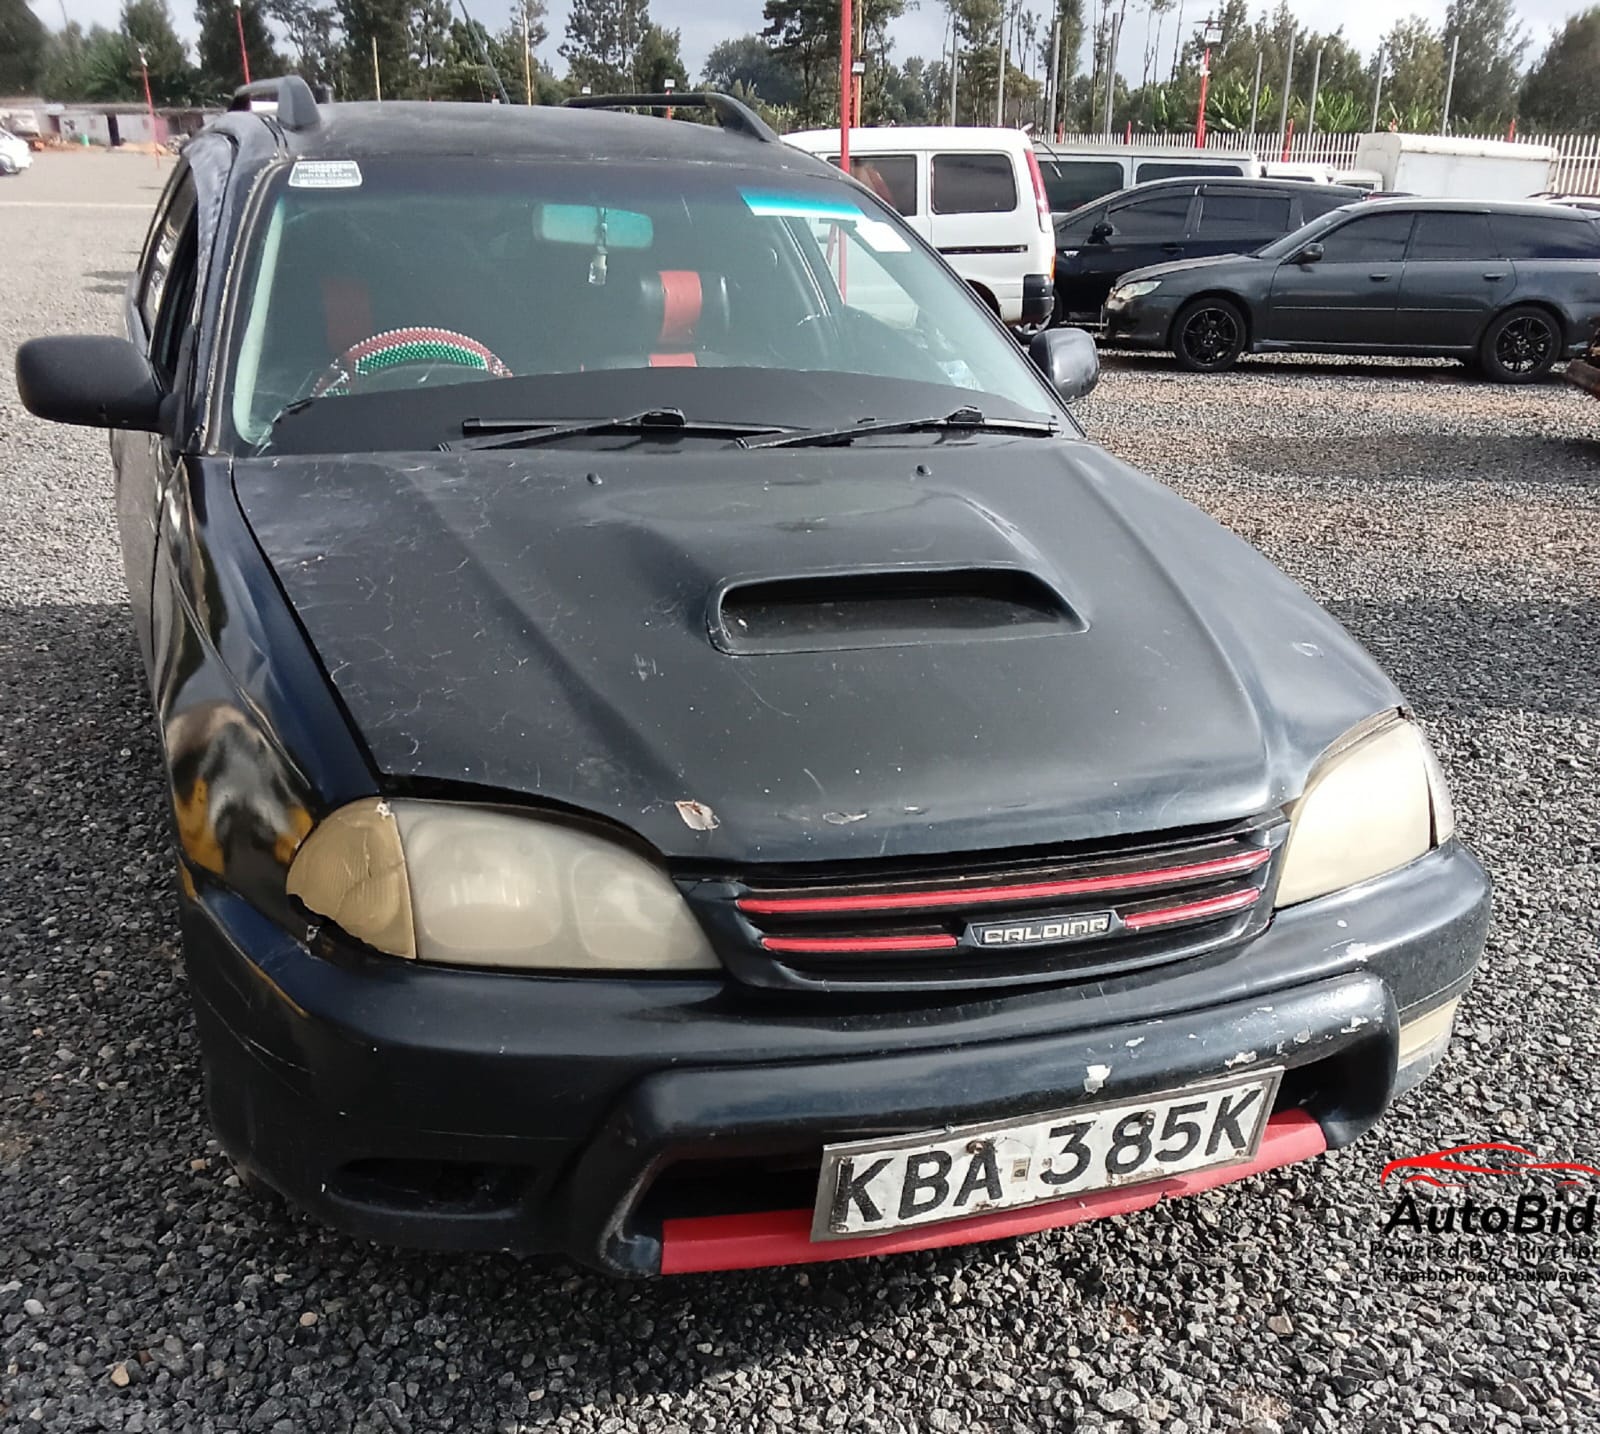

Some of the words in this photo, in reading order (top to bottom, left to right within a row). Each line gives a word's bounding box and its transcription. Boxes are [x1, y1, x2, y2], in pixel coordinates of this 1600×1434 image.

[983, 917, 1109, 944] CALDINA
[835, 1138, 1001, 1222] KBA
[1038, 1089, 1261, 1186] 385K
